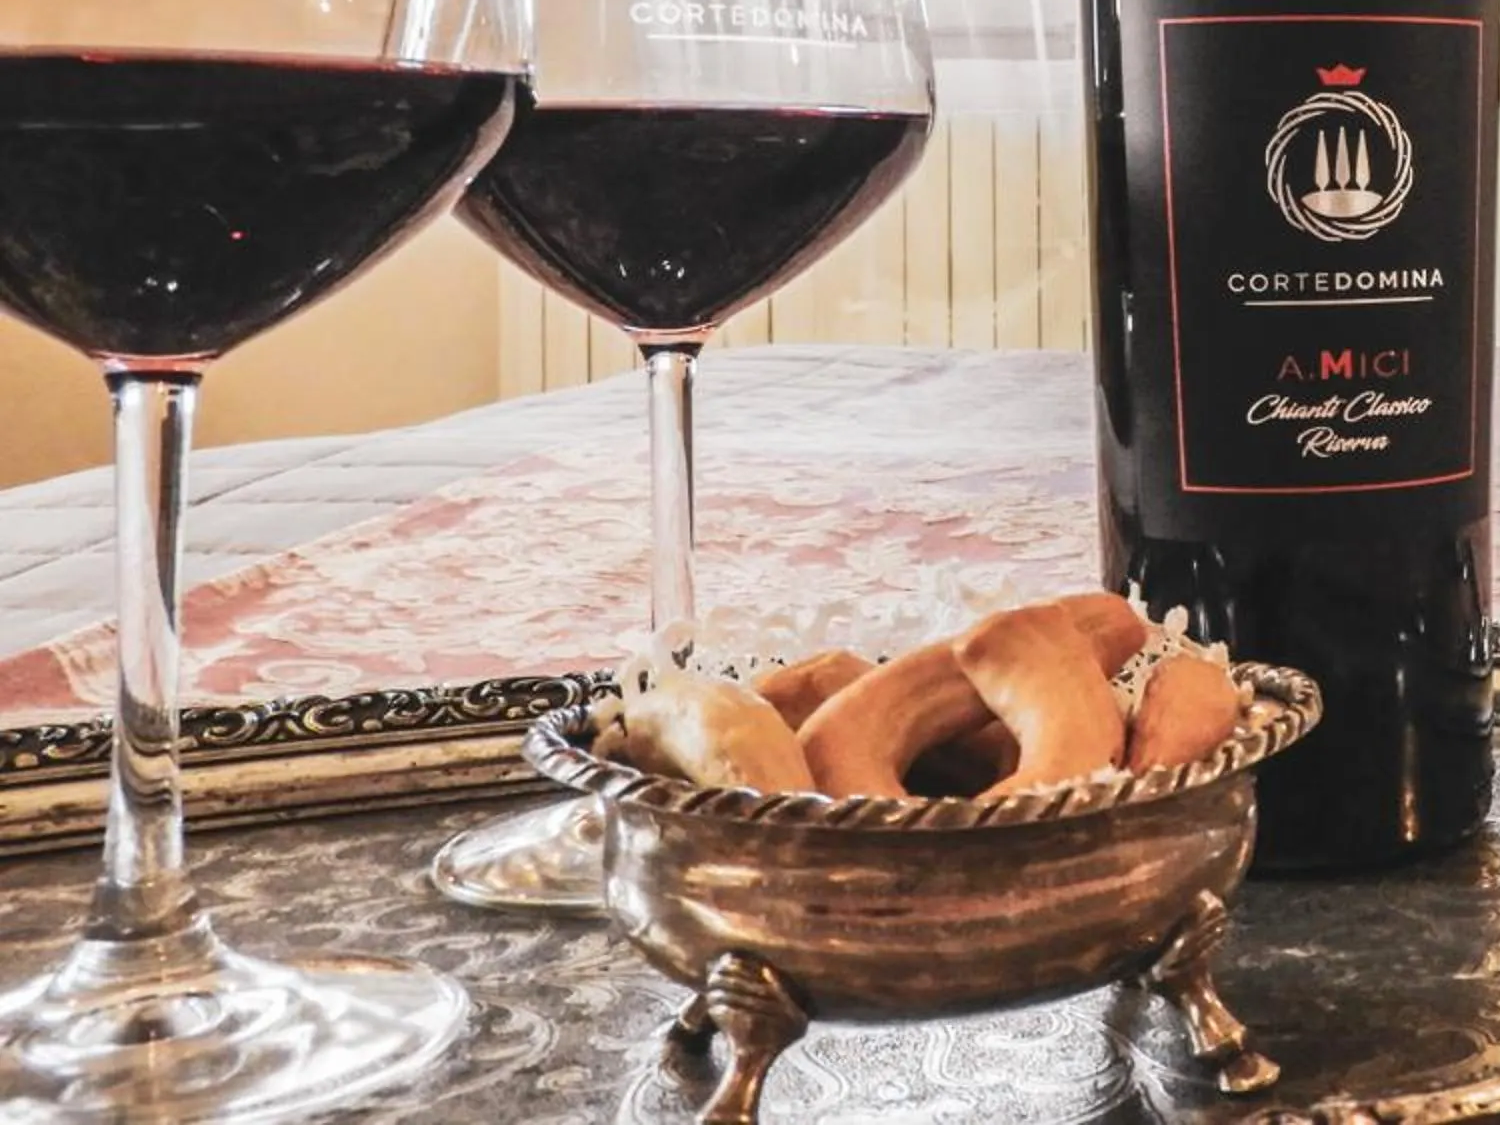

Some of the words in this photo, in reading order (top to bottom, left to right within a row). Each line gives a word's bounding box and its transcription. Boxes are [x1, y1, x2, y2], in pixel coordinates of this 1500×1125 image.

[1227, 268, 1445, 293] CORTEDOMINA
[1247, 393, 1345, 425] Chianti
[1343, 390, 1433, 423] Classico
[1297, 426, 1390, 458] Riserva
